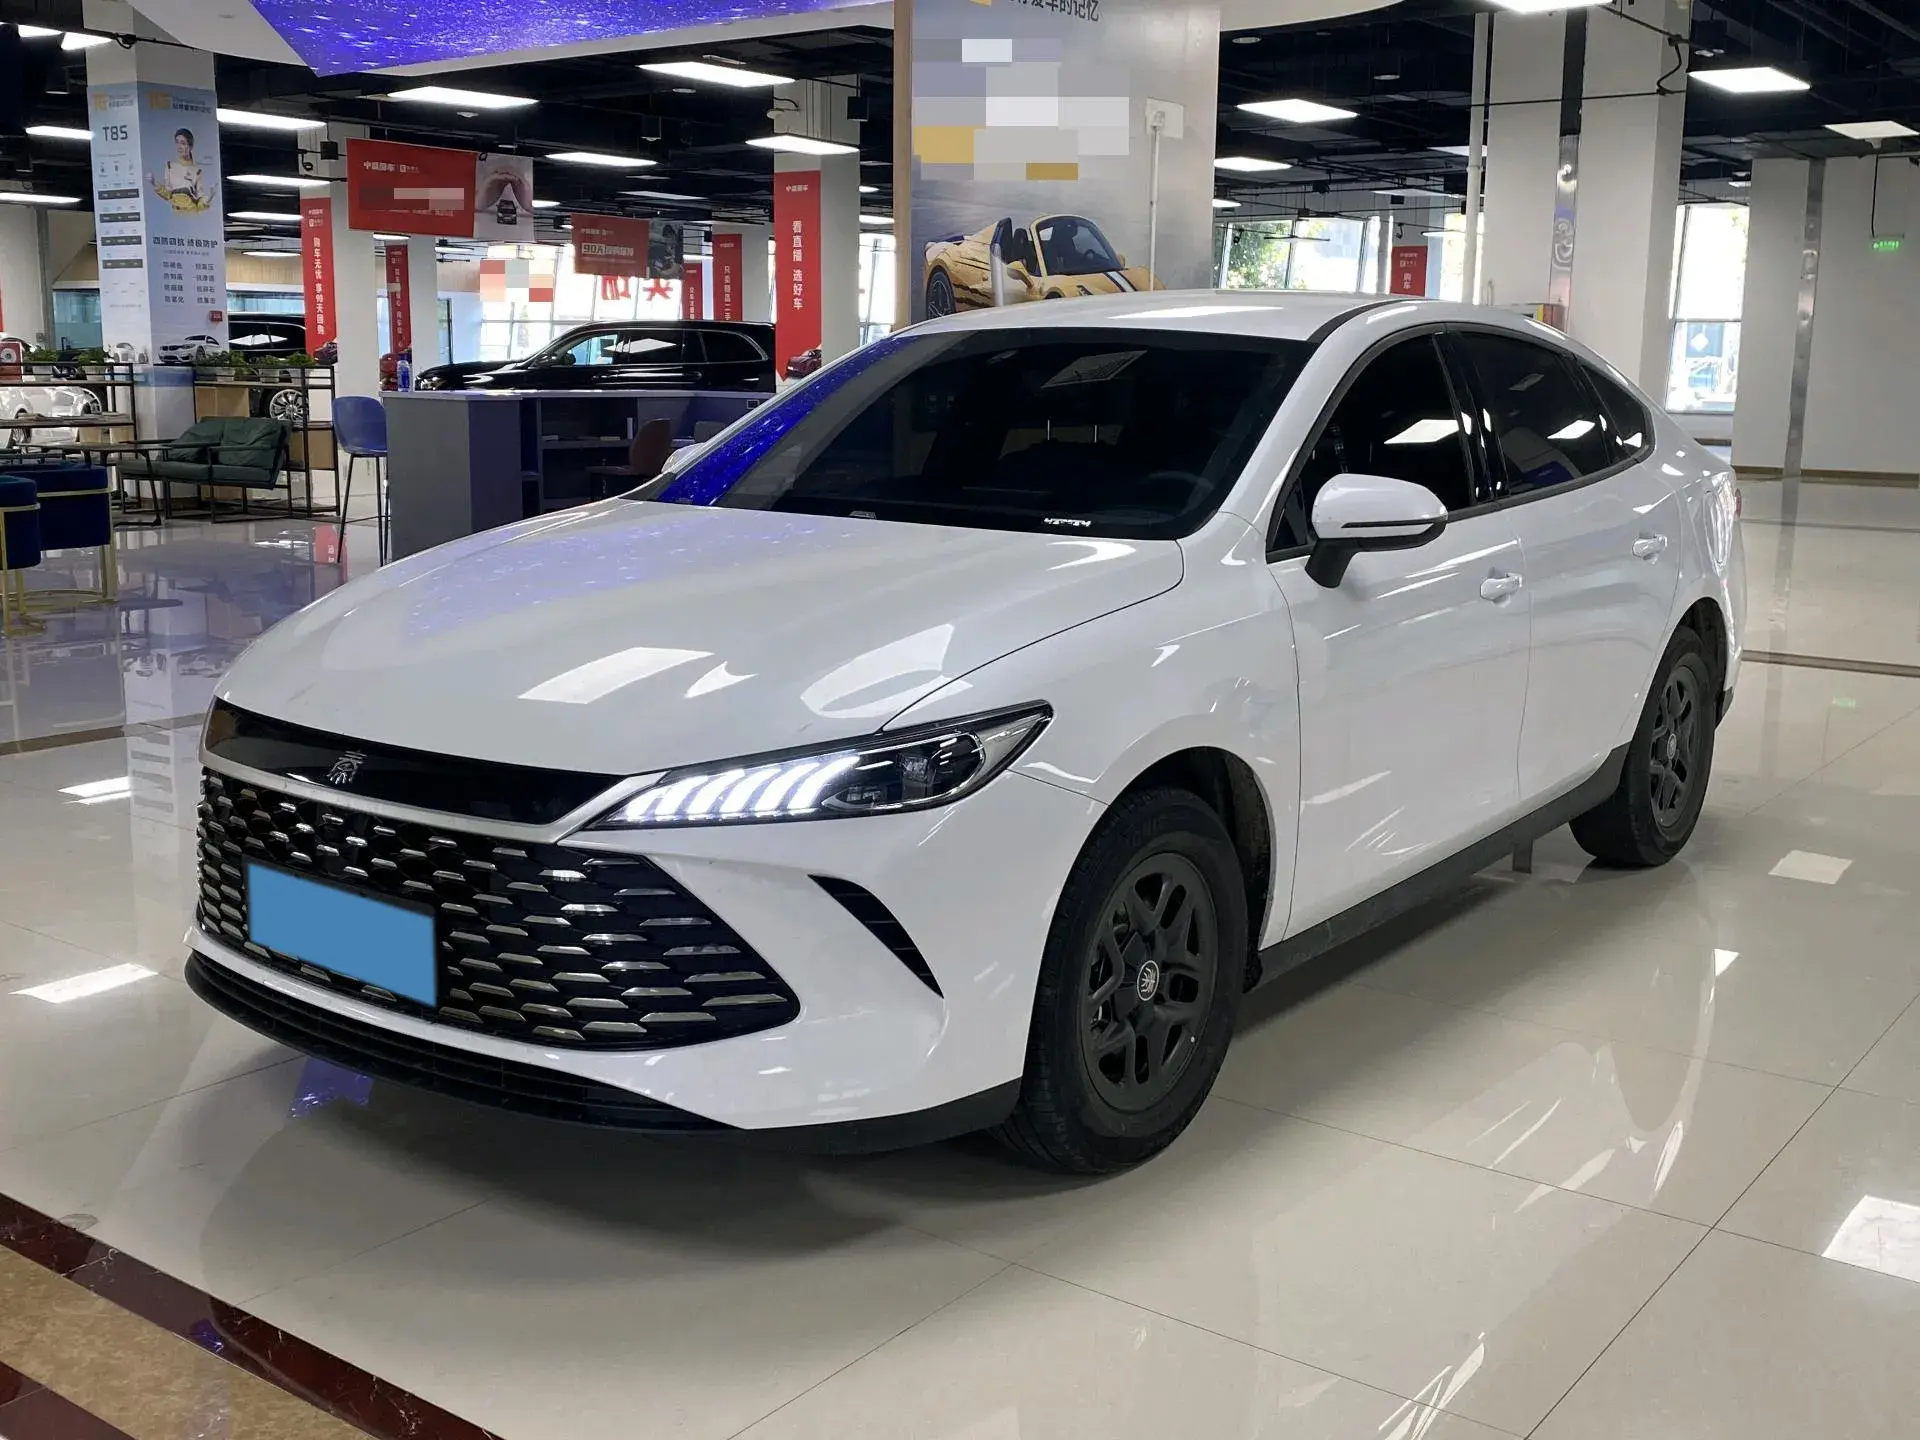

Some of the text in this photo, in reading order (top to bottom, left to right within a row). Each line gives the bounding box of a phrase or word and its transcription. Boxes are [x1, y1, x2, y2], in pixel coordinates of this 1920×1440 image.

[792, 220, 804, 311] 看直播 选好车
